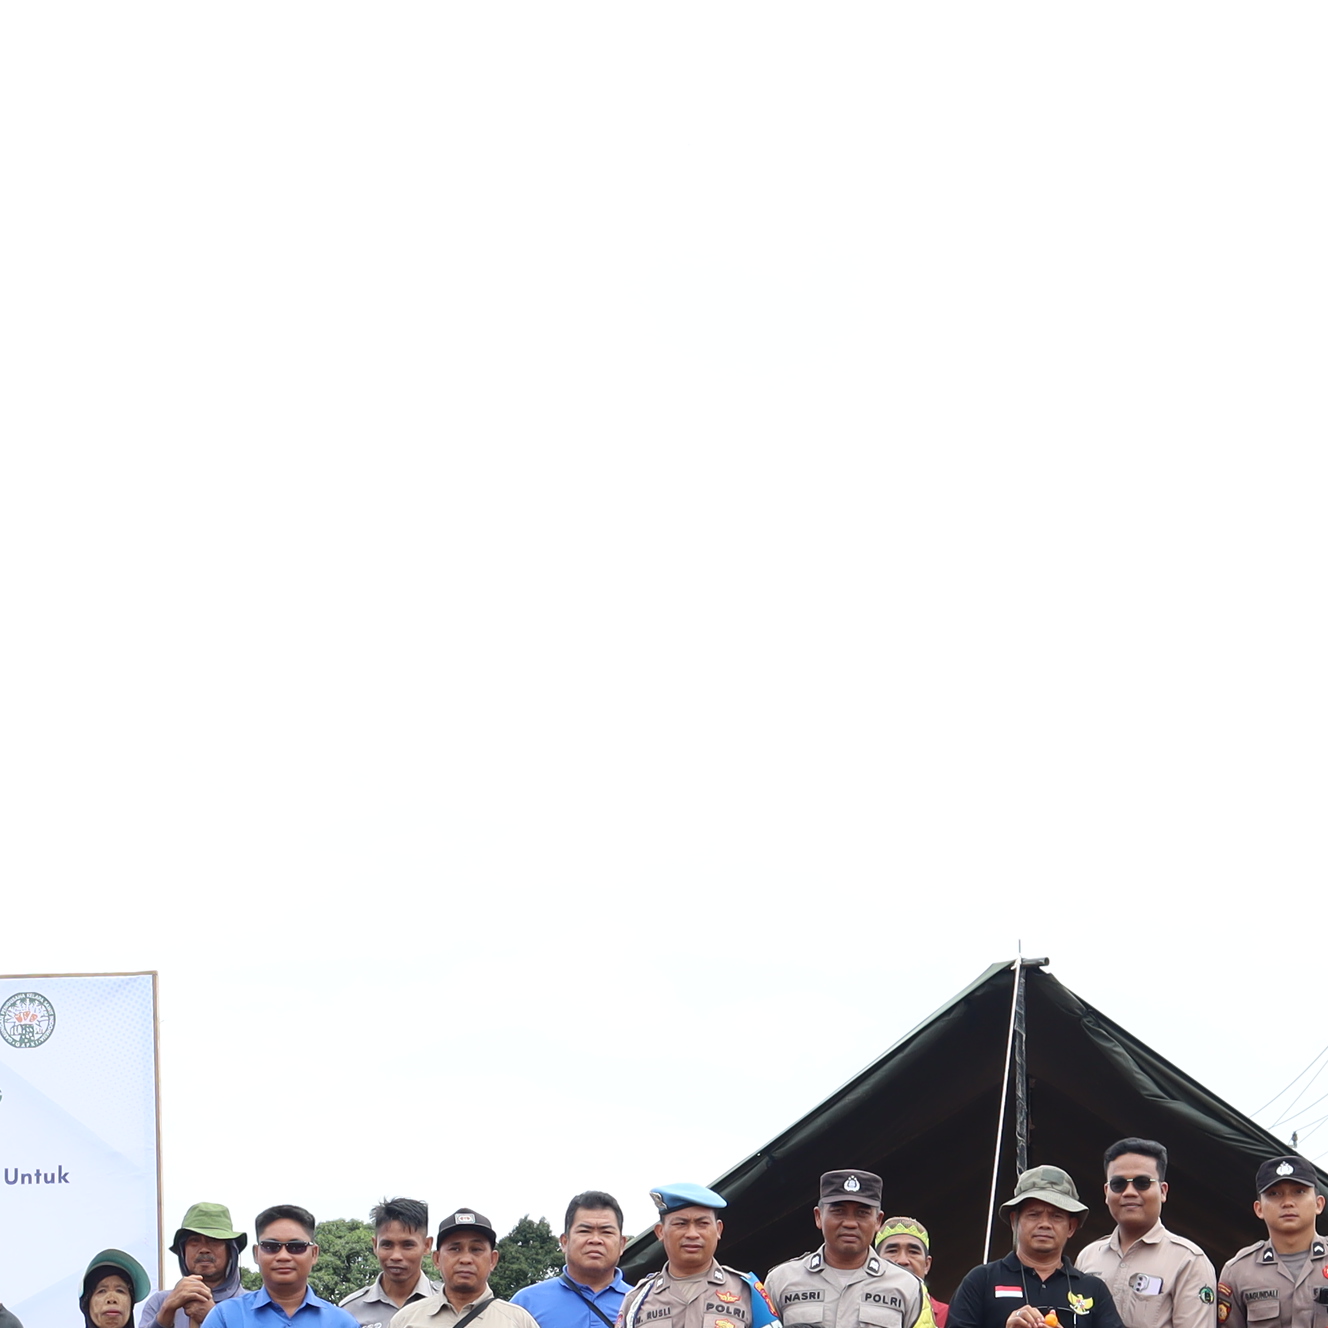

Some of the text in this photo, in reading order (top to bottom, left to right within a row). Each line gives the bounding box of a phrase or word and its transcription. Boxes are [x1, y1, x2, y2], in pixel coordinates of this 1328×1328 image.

[4, 1165, 70, 1185] Untuk
[784, 1291, 821, 1304] NASRI
[865, 1292, 902, 1308] POLRI
[647, 1307, 671, 1320] RUSLI
[706, 1302, 746, 1319] POLRI
